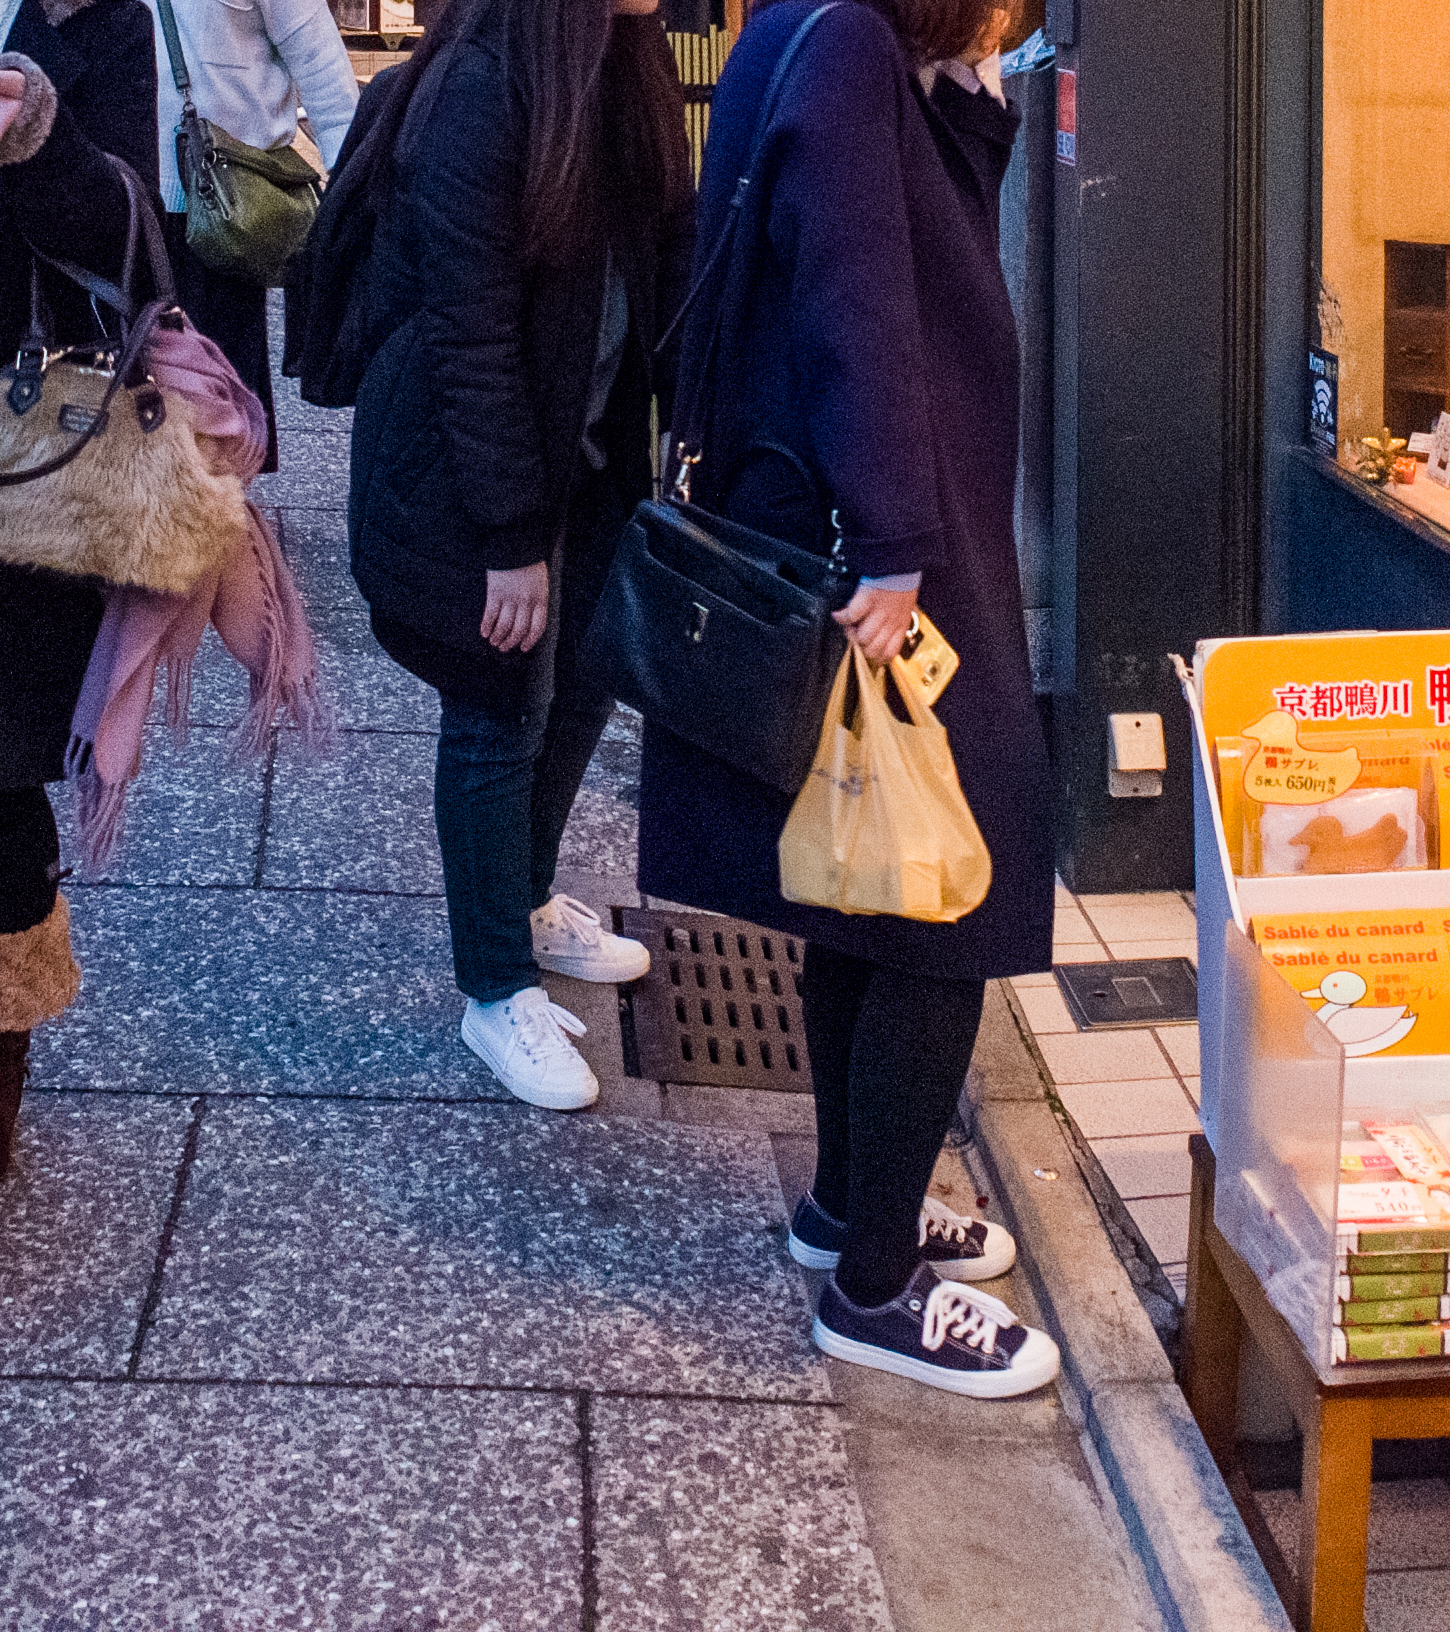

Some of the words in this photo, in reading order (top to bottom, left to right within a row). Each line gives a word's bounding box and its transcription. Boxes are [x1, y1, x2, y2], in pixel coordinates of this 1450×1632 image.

[1275, 682, 1411, 718] 京都鴨川
[1264, 924, 1320, 940] Sablé
[1326, 923, 1350, 938] du
[1356, 921, 1426, 937] canard
[1272, 950, 1330, 967] Sablé
[1336, 949, 1361, 965] du
[1368, 948, 1439, 965] canard
